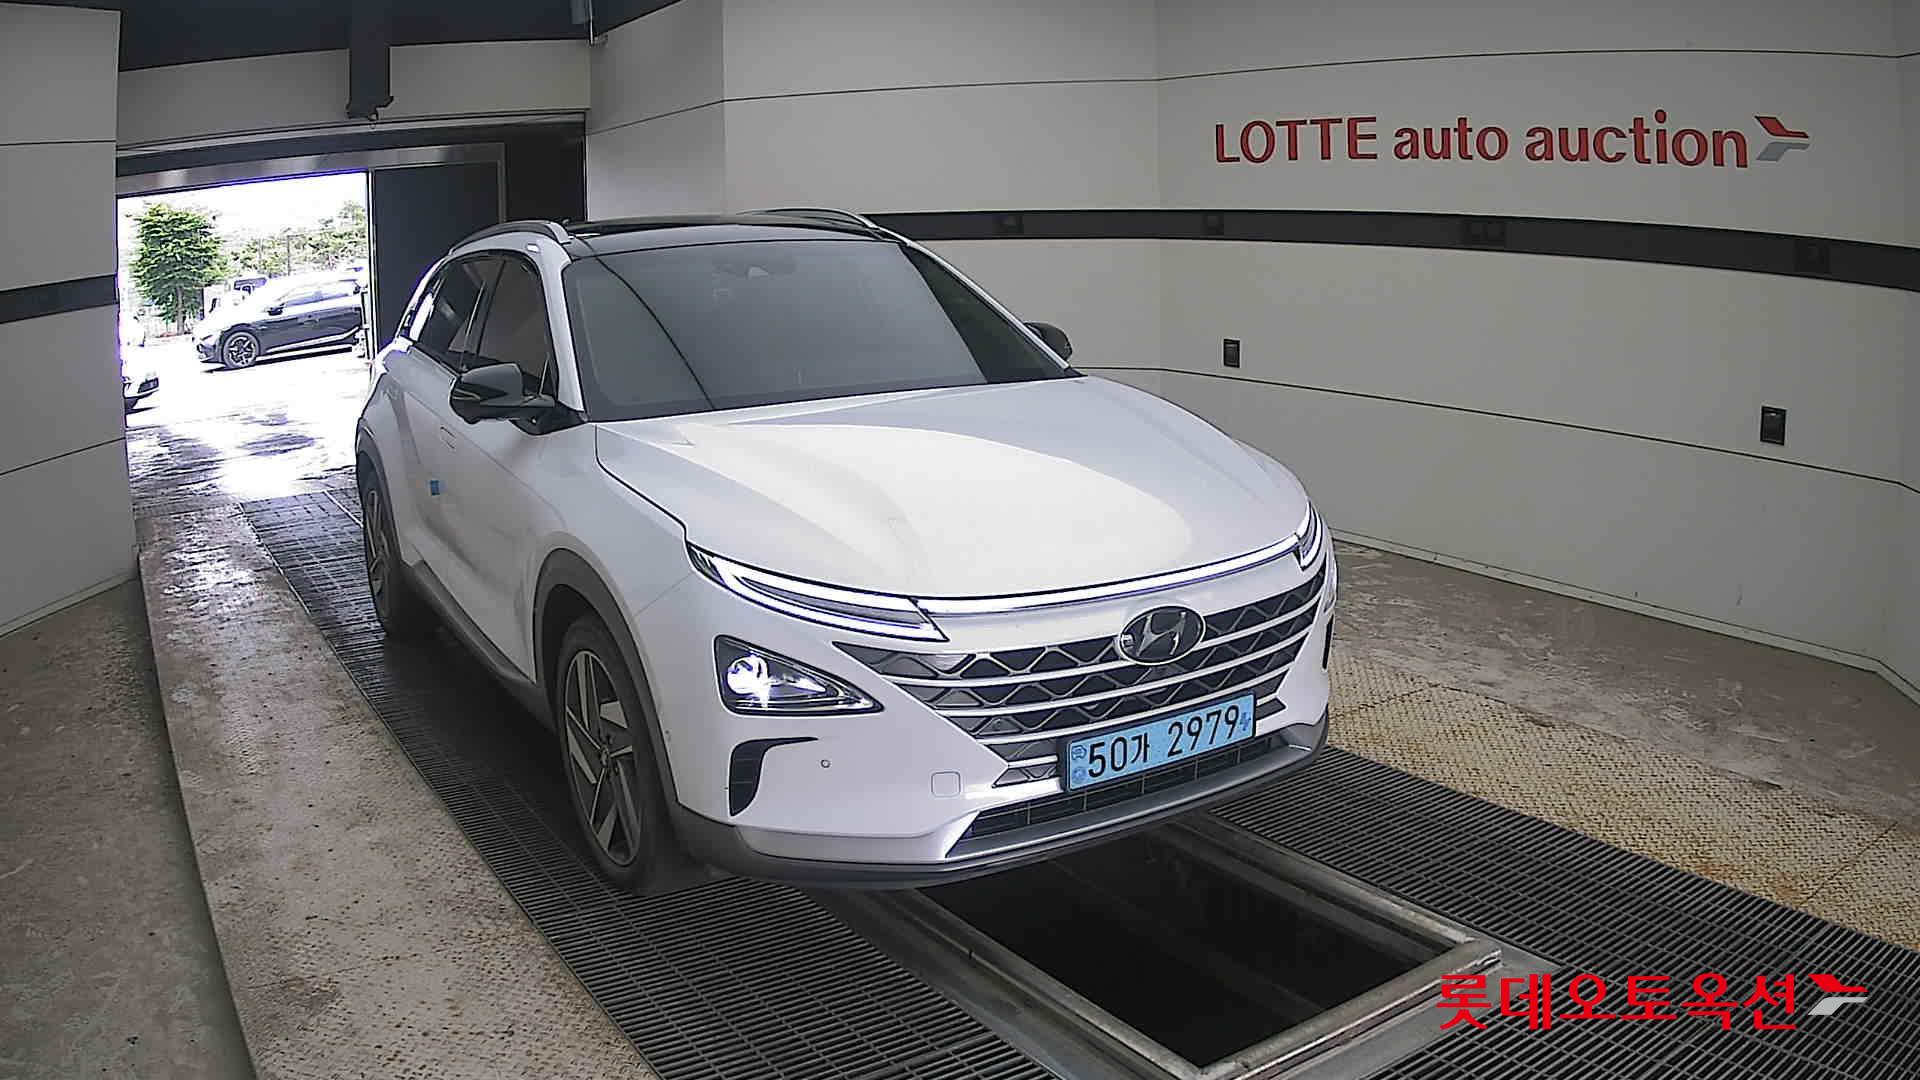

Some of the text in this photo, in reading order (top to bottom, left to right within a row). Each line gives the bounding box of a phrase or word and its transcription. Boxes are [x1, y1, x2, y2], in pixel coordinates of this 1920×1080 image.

[1214, 109, 1749, 168] LOTTE auto auction
[1088, 704, 1240, 778] 50가 2979
